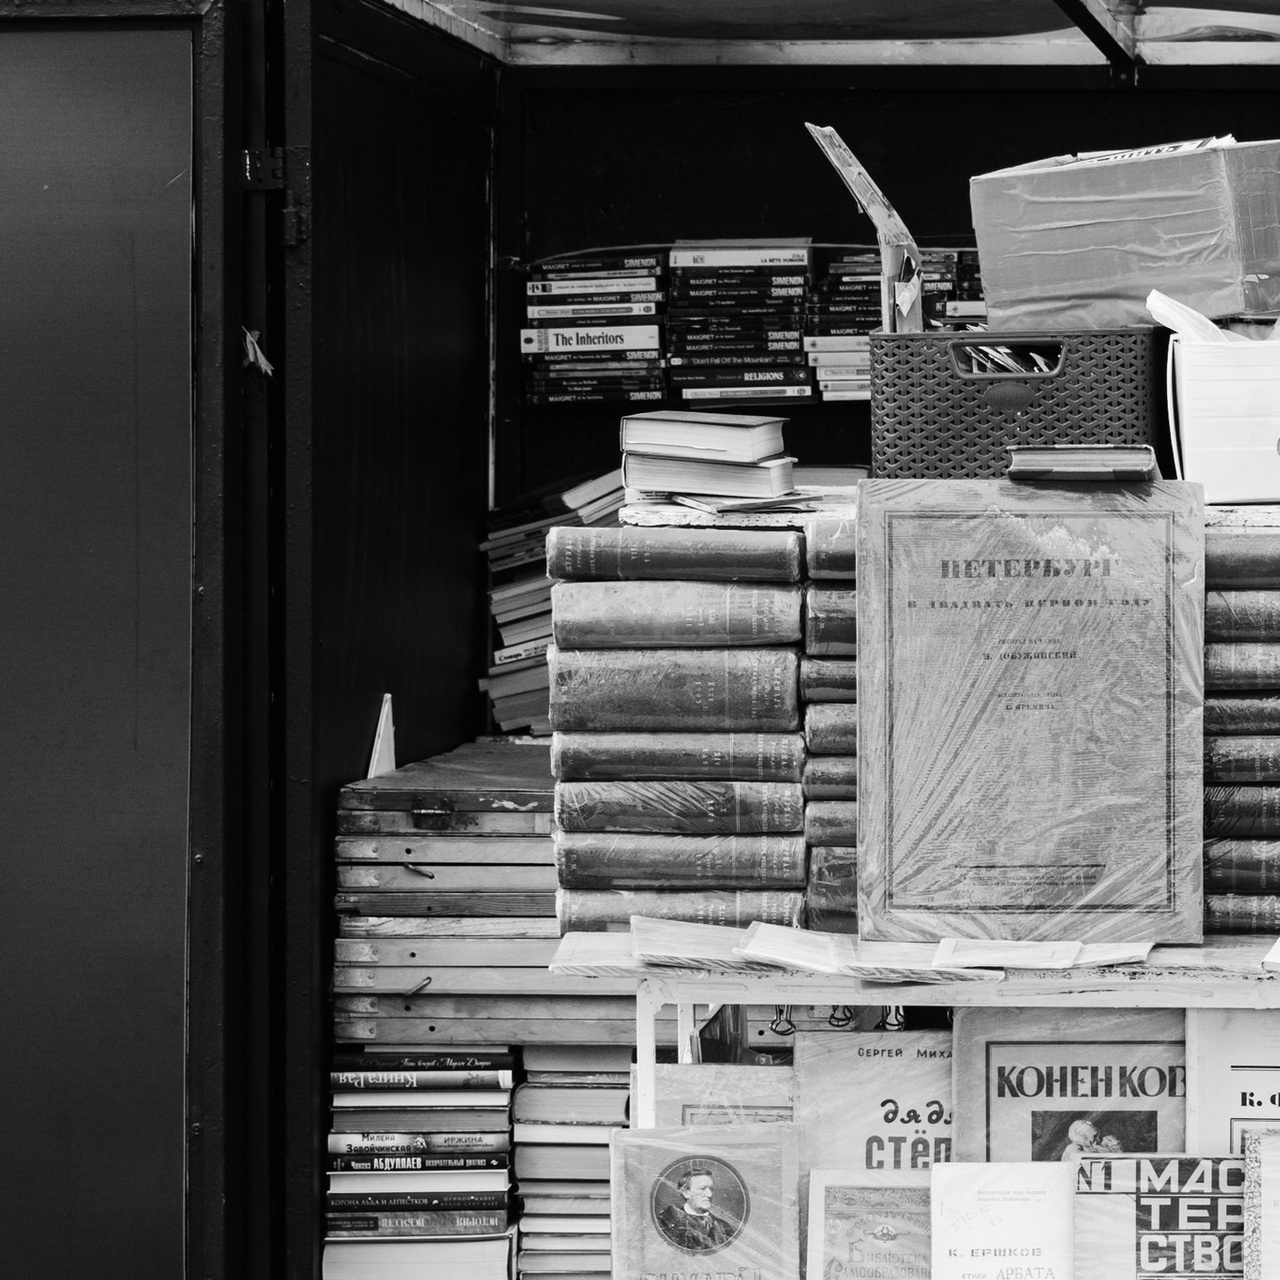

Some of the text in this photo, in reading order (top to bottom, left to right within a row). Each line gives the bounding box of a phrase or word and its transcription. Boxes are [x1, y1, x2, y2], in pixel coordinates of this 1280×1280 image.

[624, 258, 656, 268] SIMENON
[772, 276, 804, 285] SIMENON
[771, 288, 803, 297] SIMENON
[630, 293, 663, 302] SIMENON
[553, 332, 625, 346] The Inheritors
[768, 331, 799, 340] SIMENON
[768, 342, 799, 350] SIMENON
[626, 351, 658, 360] SIMENON
[744, 372, 784, 381] RELIGIONS
[630, 391, 662, 400] SIMENON
[857, 1047, 903, 1058] СЕРГЕЙ
[338, 1072, 418, 1088] Книга Рая
[997, 1065, 1186, 1098] КОНЕНКОВ
[1241, 1092, 1263, 1107] К.
[361, 1133, 396, 1142] МИЛЕНА
[444, 1136, 483, 1144] ИРЖИНА
[346, 1143, 411, 1153] ЗАВОЙЧИНСКАЯ
[373, 1158, 422, 1170] АБДУЛЛАЕВ
[1140, 1197, 1244, 1230] ТЕР
[456, 1218, 498, 1226] ИСТОРИЯ
[949, 1247, 1042, 1257] К. ЕРШКОВ
[996, 1267, 1056, 1280] АРБАТА
